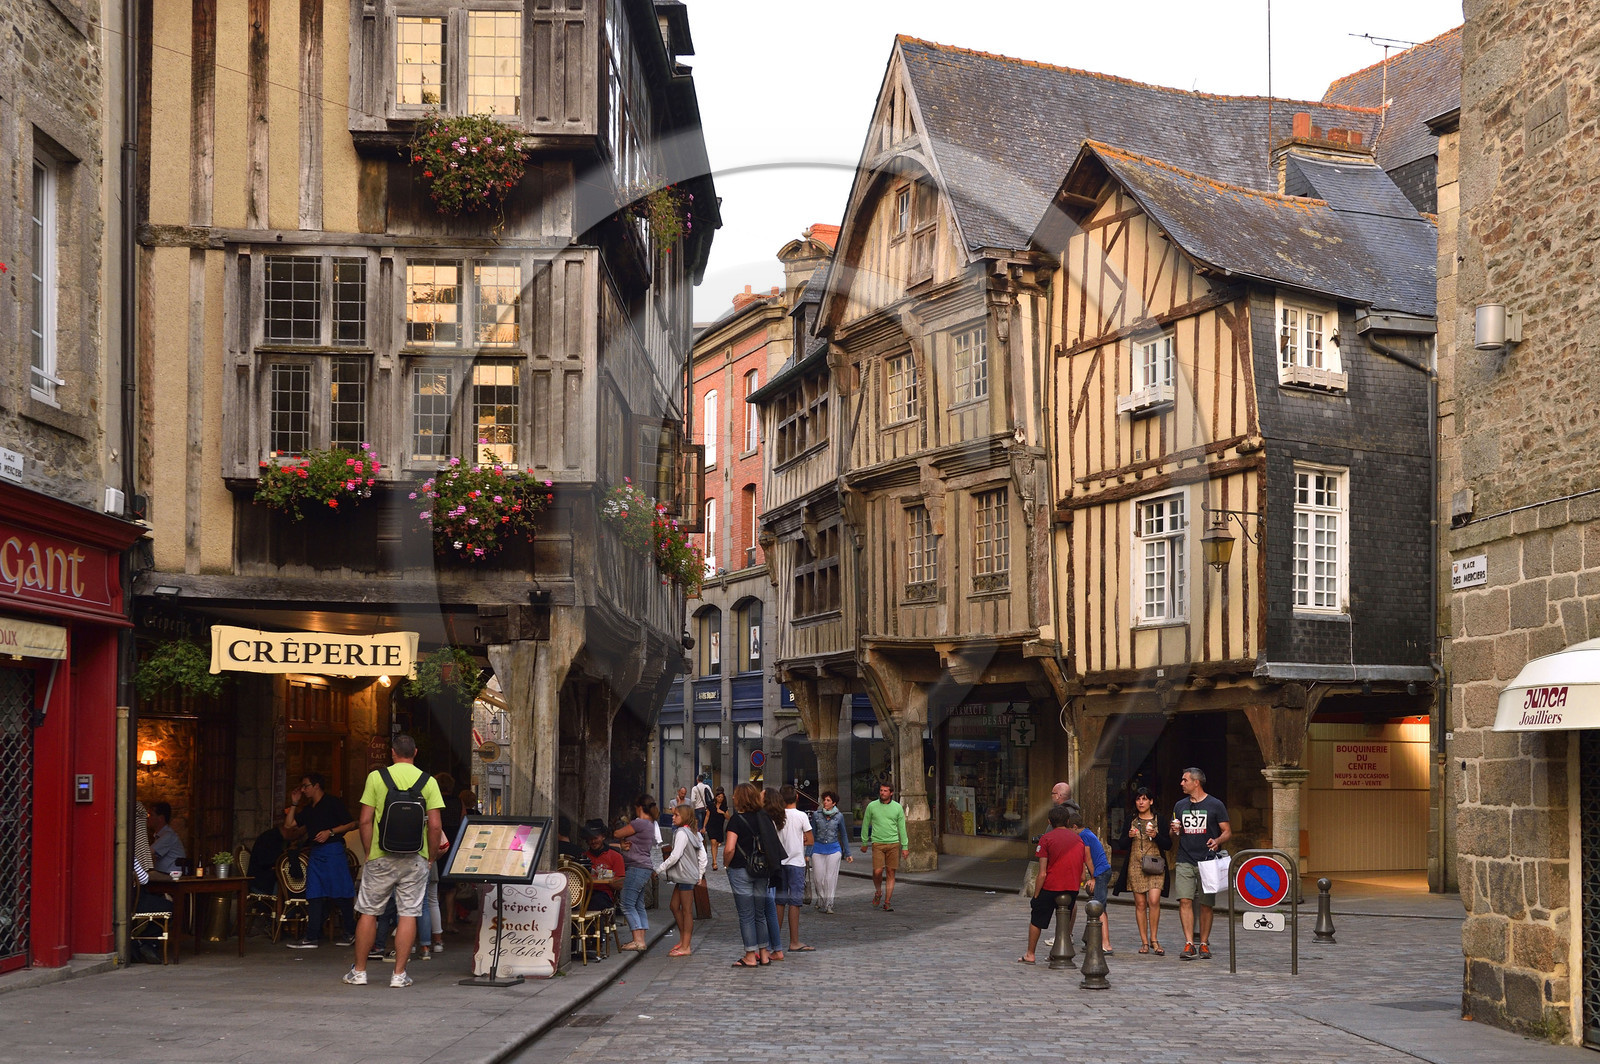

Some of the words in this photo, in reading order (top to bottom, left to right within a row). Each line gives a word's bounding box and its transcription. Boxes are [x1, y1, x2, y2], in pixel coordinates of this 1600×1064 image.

[1462, 561, 1475, 570] PLACE
[1453, 576, 1461, 585] DES
[1463, 571, 1486, 582] MERCIERS
[228, 637, 402, 667] CRÊPERIE
[1523, 686, 1569, 709] JUNCA
[1518, 711, 1563, 726] Joailliers
[1336, 745, 1388, 753] BOUQUINERIE
[1356, 754, 1368, 762] DU
[1348, 762, 1377, 770] CENTRE
[1183, 816, 1206, 828] 537
[488, 916, 539, 931] Snack
